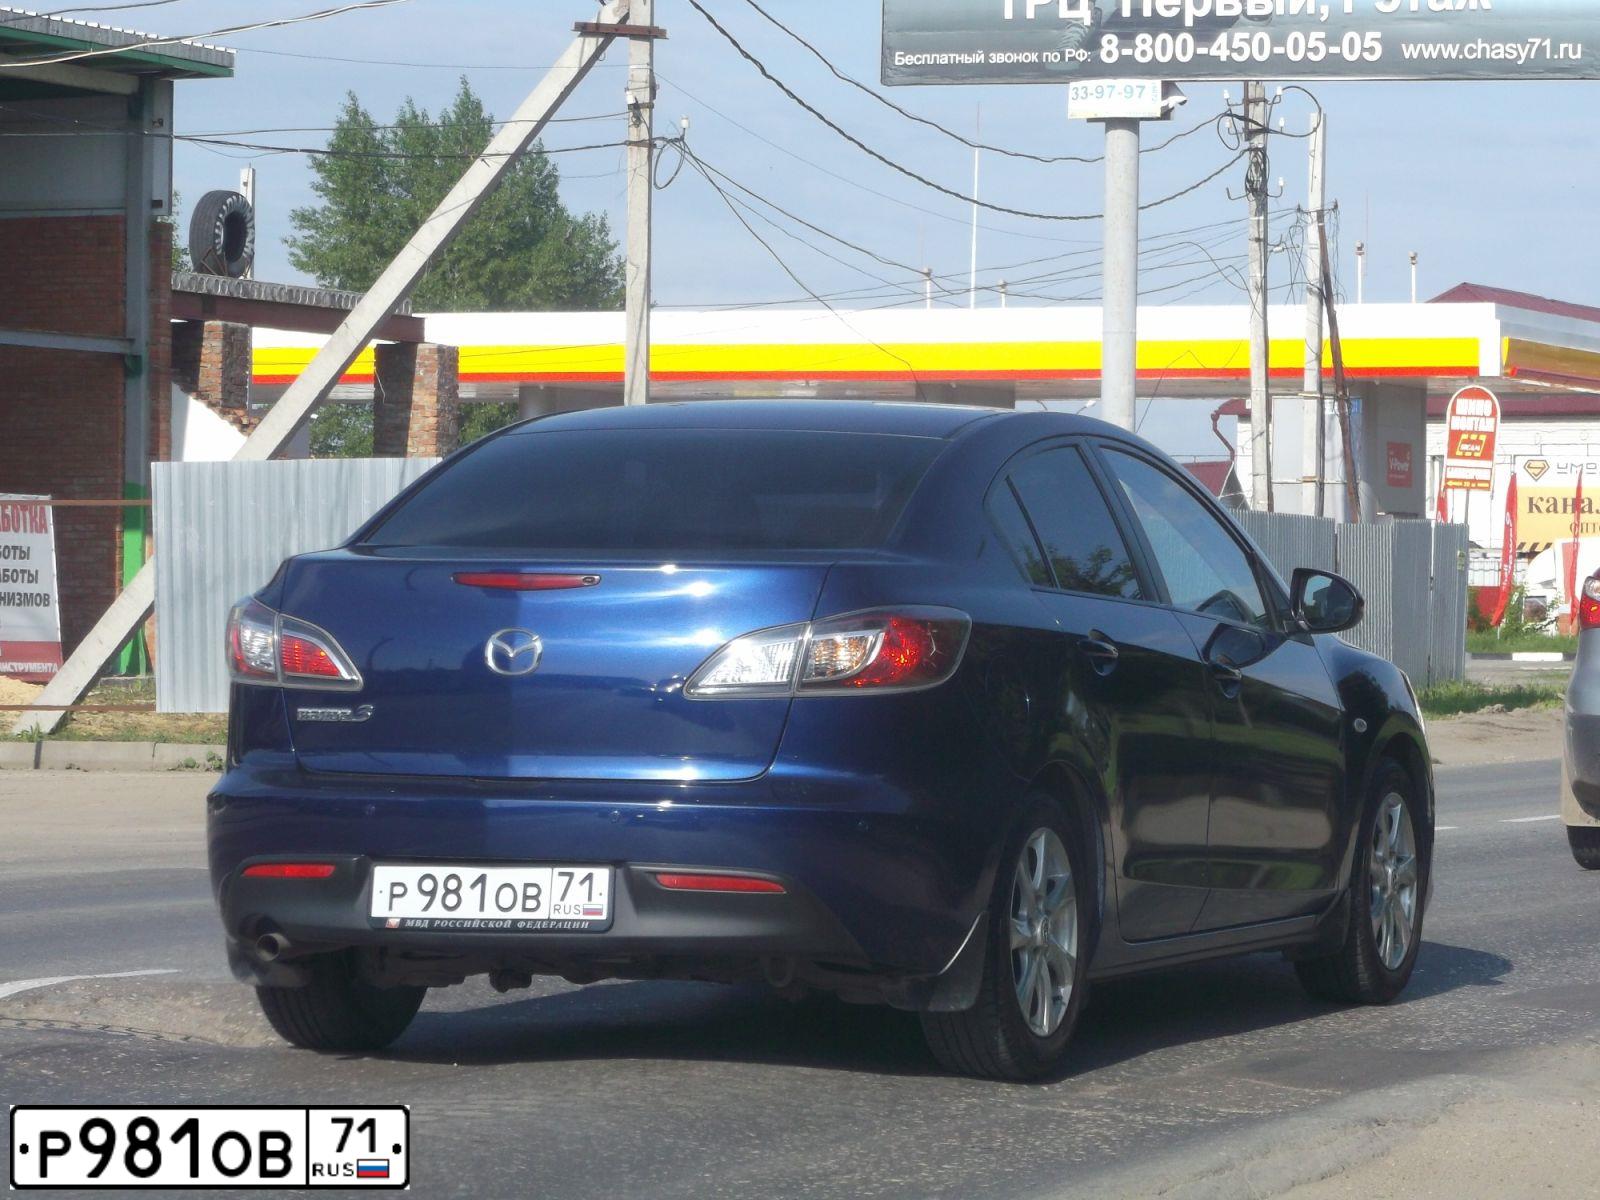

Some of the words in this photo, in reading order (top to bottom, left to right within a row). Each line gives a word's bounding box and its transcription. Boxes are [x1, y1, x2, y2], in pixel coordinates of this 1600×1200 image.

[894, 50, 985, 66] Бесплатный
[988, 52, 1039, 64] звонок
[1042, 52, 1061, 63] по
[1065, 49, 1092, 63] РФ:
[1099, 31, 1383, 64] 8-800-450-05-05
[1401, 38, 1582, 65] www.chasy71.ru
[1071, 84, 1146, 101] 33-97-97
[0, 504, 48, 534] БОТКА
[0, 545, 31, 560] ОТЫ
[0, 568, 39, 584] БОТЫ
[557, 871, 594, 902] 71
[553, 903, 581, 915] RUS
[404, 919, 429, 928] МВД
[434, 918, 512, 929] РОССИЙСКОЙ
[516, 918, 590, 929] ФЕДЕРАЦИИ
